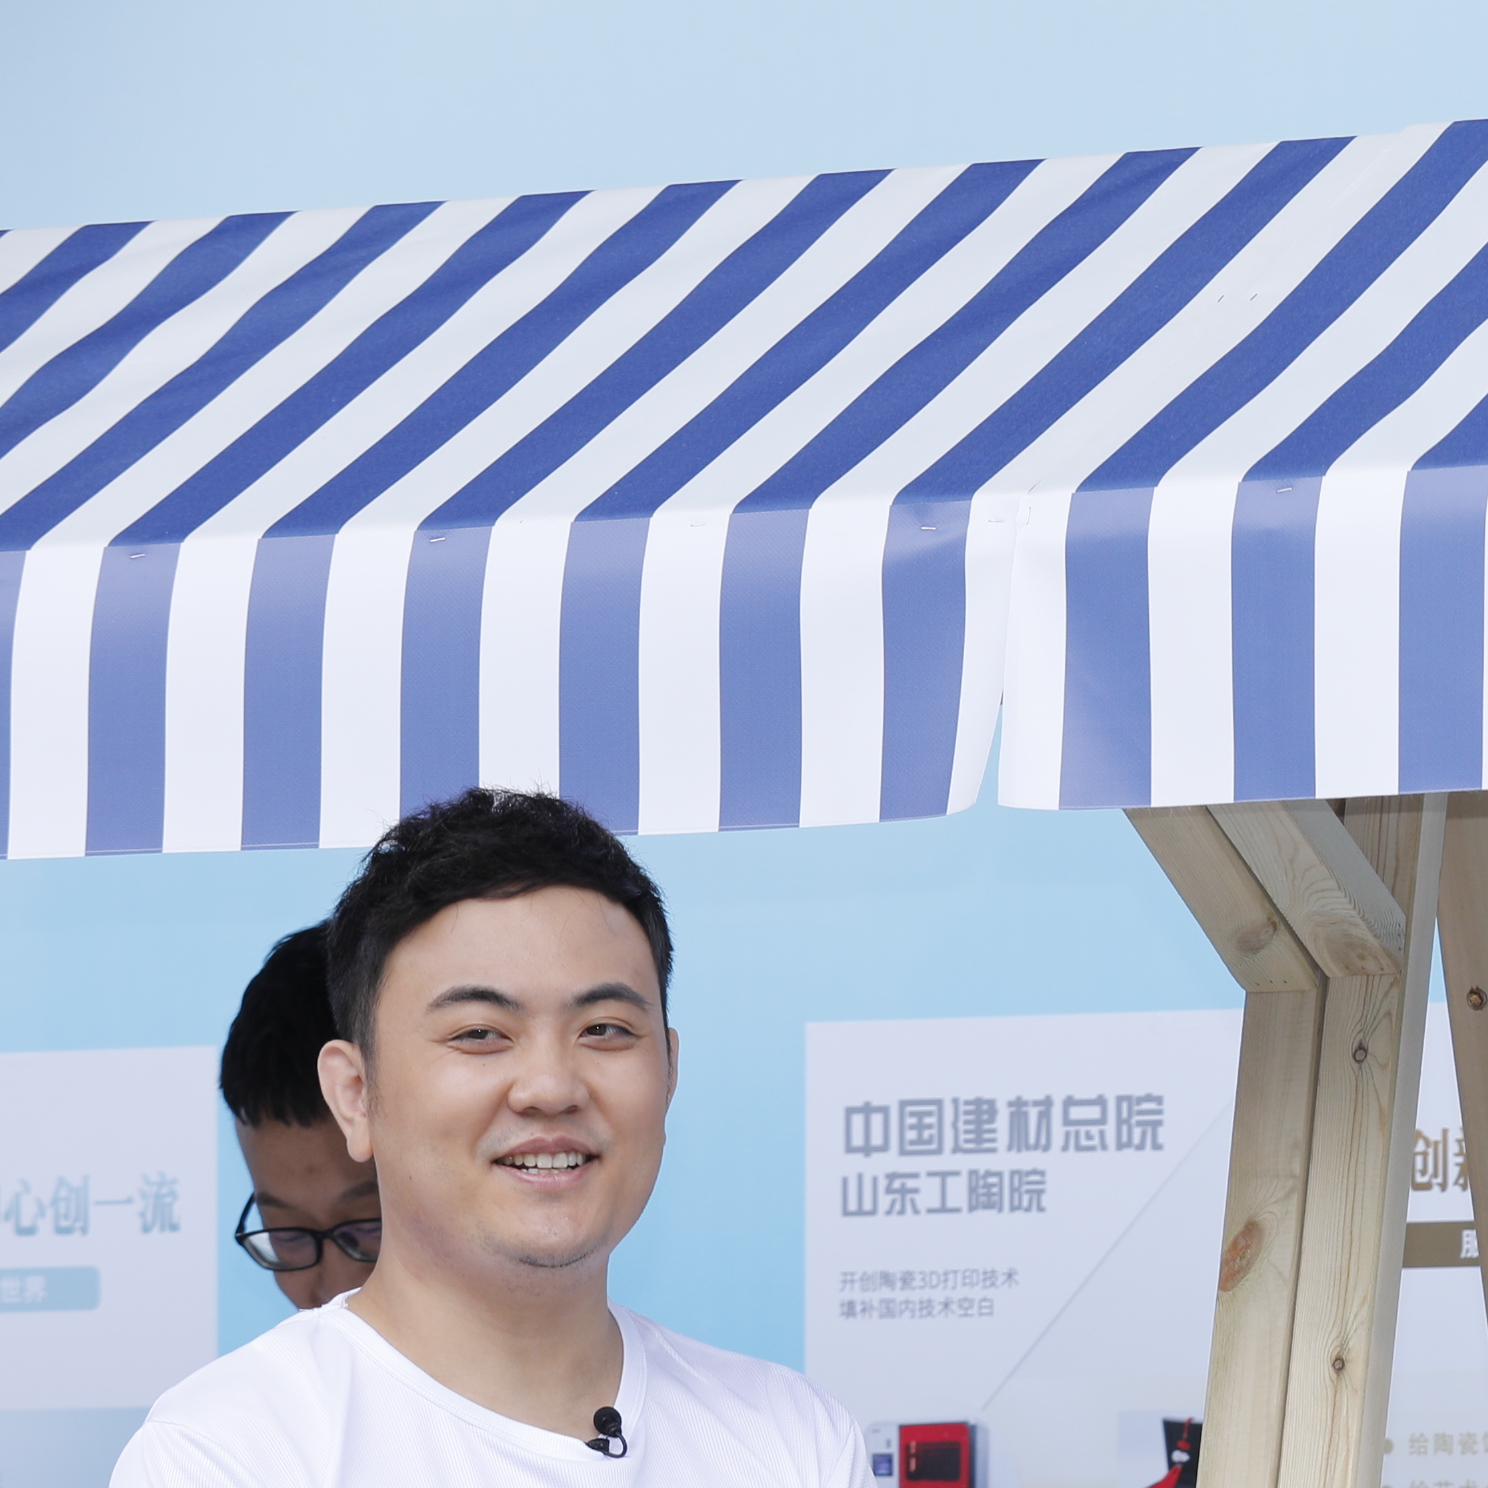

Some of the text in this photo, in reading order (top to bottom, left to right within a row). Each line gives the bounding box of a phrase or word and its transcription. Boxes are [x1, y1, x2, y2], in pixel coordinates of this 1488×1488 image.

[842, 1093, 1165, 1158] 中国建材总院
[840, 1167, 1047, 1218] 山东工陶院
[838, 1266, 1020, 1293] 开创陶瓷3D打印技术
[838, 1297, 995, 1321] 填补国内技术空白
